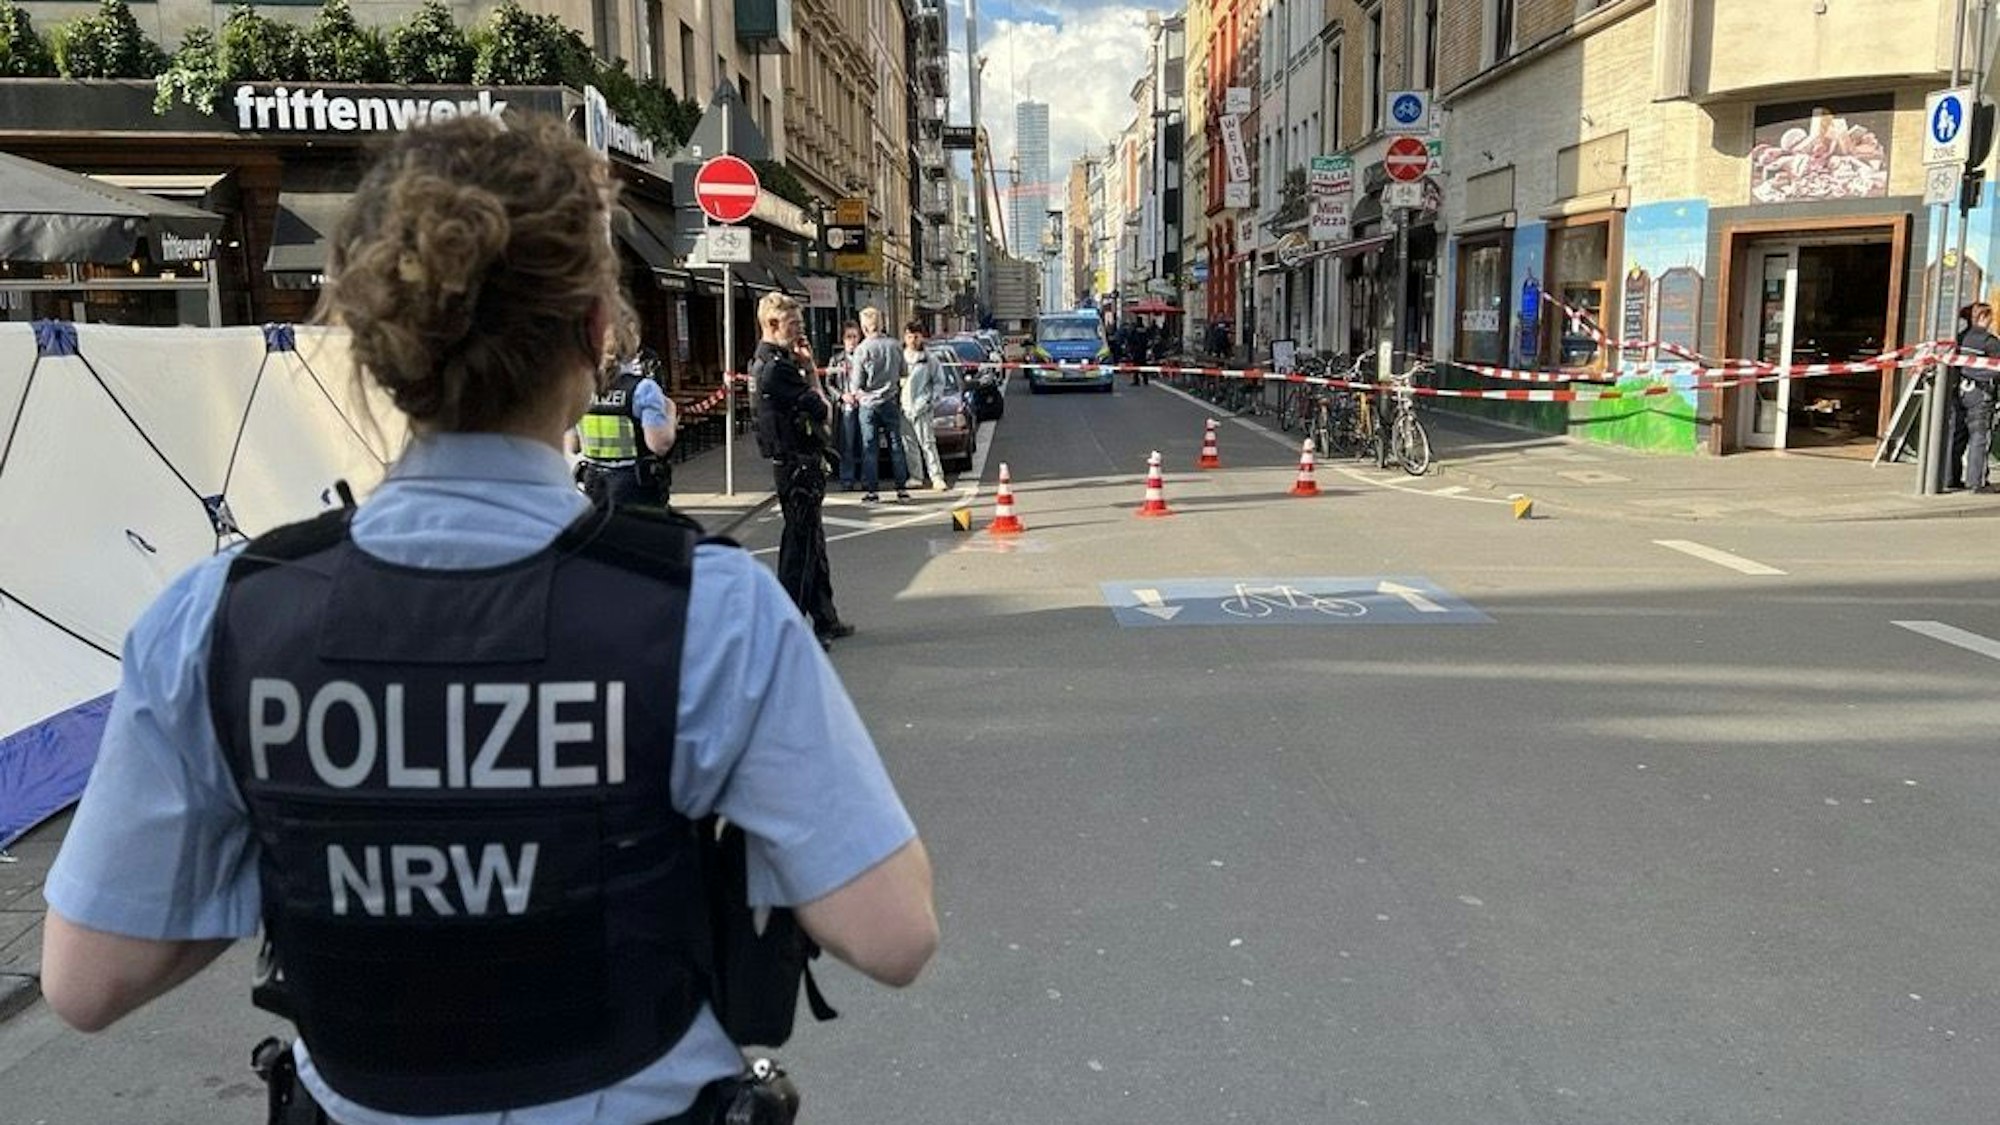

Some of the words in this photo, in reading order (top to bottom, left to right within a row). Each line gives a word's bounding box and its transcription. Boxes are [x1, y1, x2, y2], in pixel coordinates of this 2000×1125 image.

[234, 85, 508, 131] frittenwerk
[1932, 144, 1956, 159] ZONE
[1312, 215, 1346, 227] Pizza
[1316, 201, 1343, 214] Mini
[249, 678, 625, 788] POLIZEI
[326, 842, 539, 917] NRW
